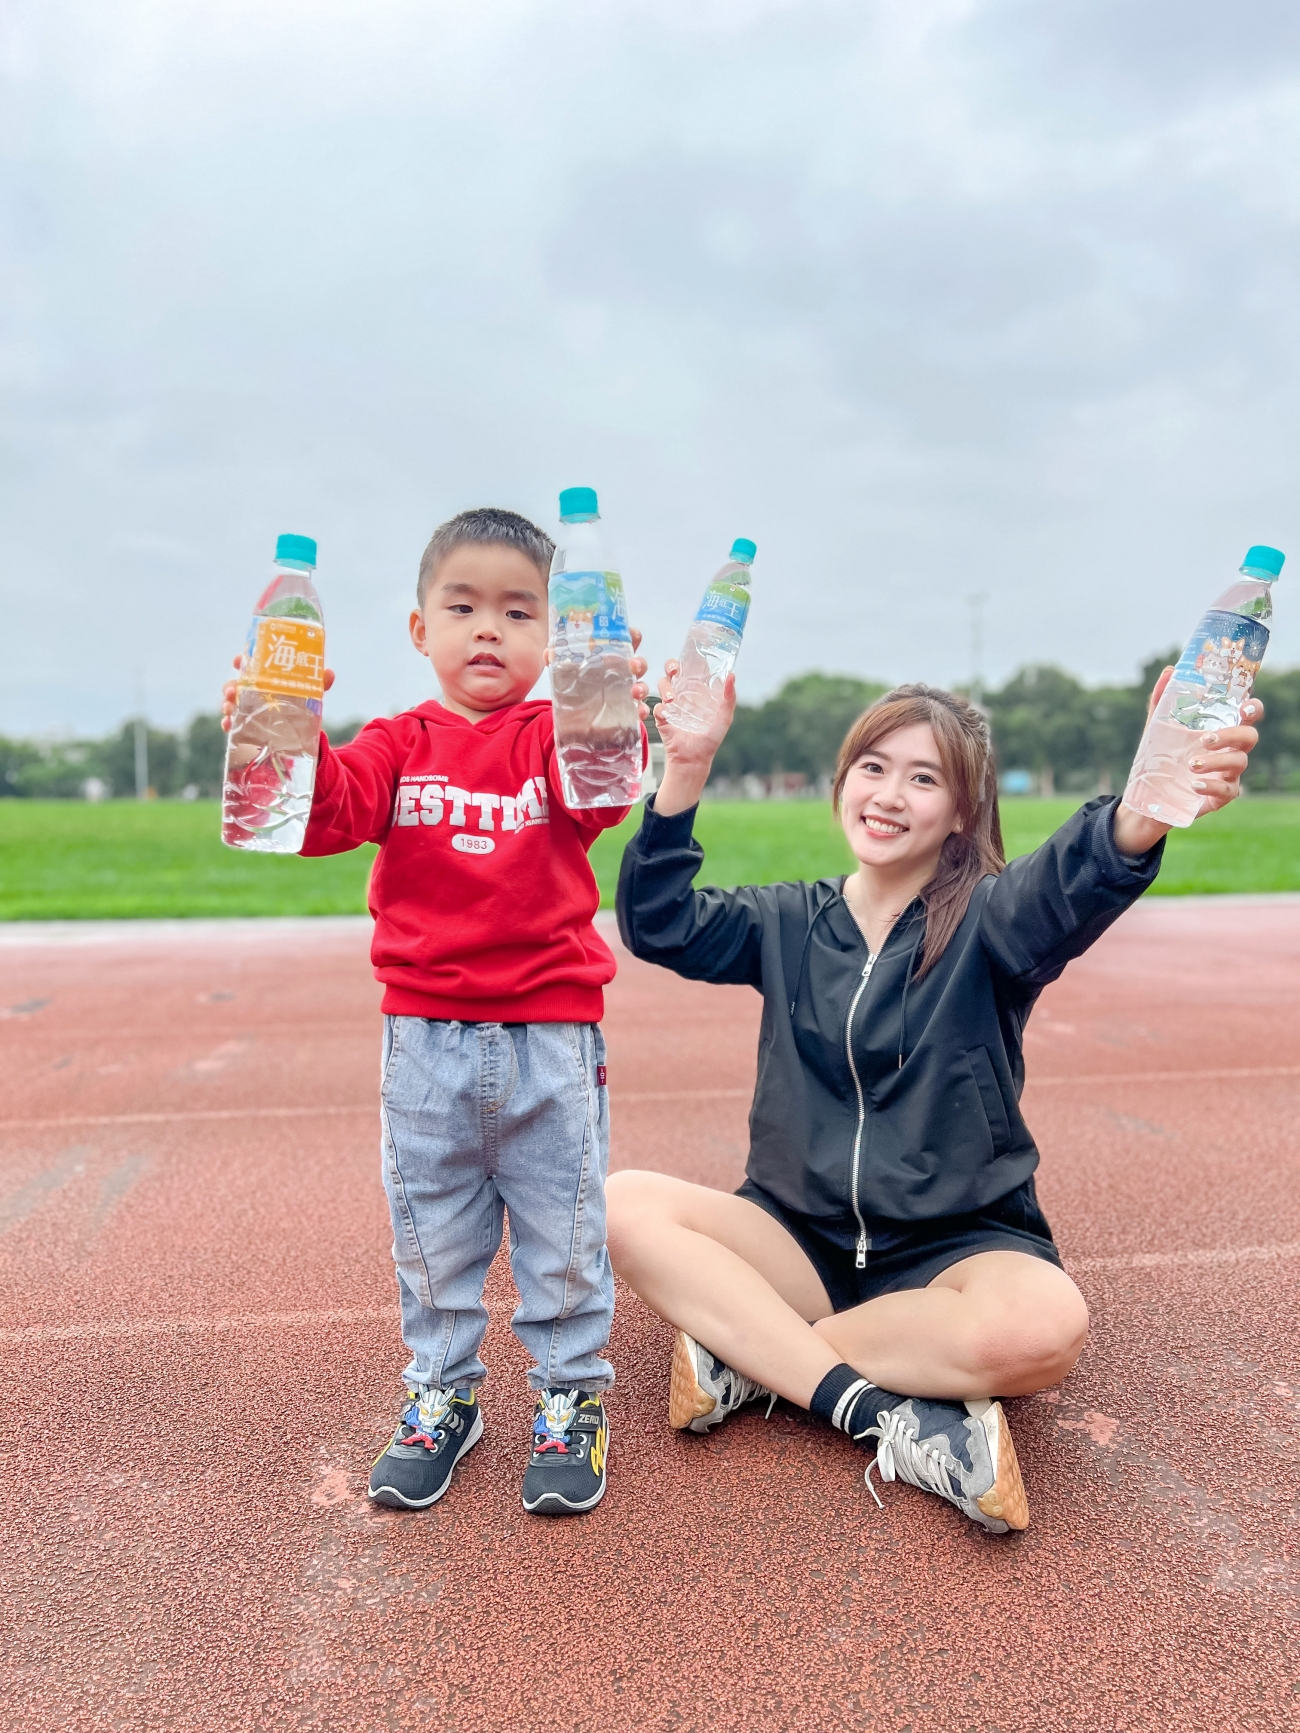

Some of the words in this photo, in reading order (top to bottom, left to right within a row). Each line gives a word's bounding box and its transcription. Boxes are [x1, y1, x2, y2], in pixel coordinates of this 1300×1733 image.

[264, 633, 324, 681] 海底王
[411, 775, 449, 783] HANDSOME
[460, 837, 488, 850] 1983
[577, 1413, 600, 1425] ZERO
